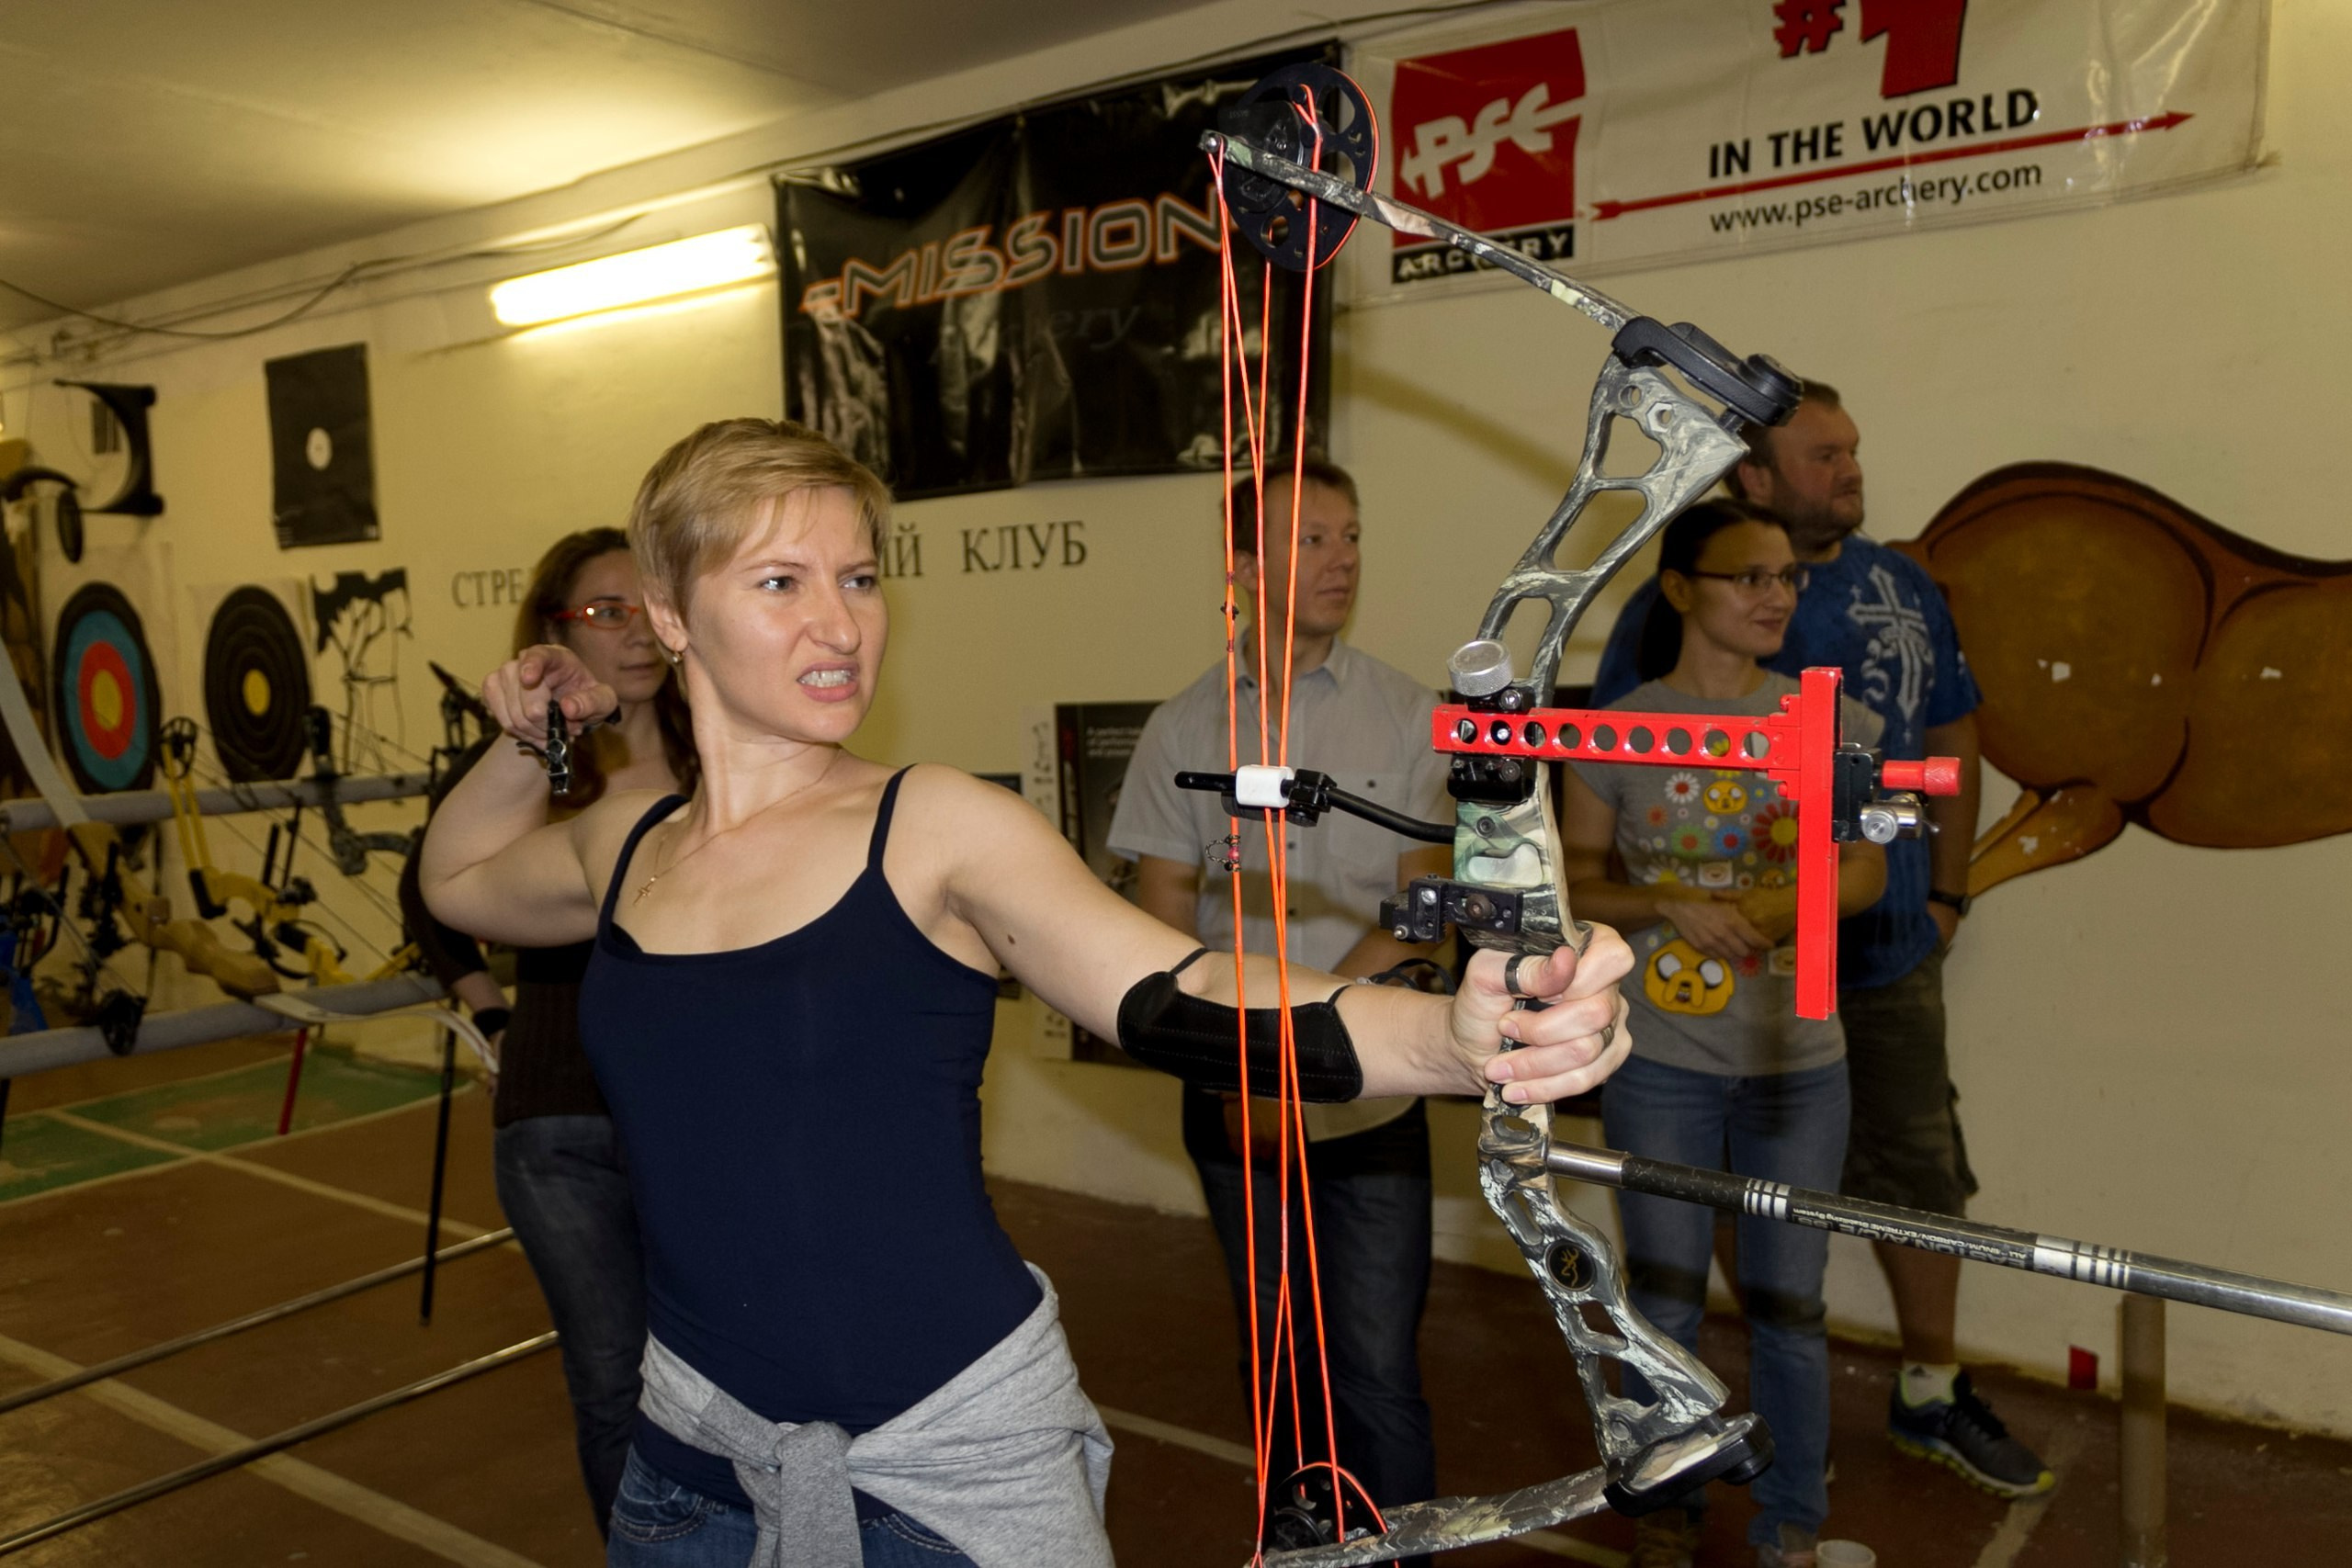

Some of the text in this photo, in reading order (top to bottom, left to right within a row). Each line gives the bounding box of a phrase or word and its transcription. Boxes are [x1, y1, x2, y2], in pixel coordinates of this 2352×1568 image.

[1709, 88, 2038, 178] IN THE WORLD
[1710, 164, 2042, 231] www.pse-archery.com
[840, 186, 1225, 319] MISSION
[1396, 231, 1569, 277] ARCRY
[961, 520, 1088, 573] КЛУБ
